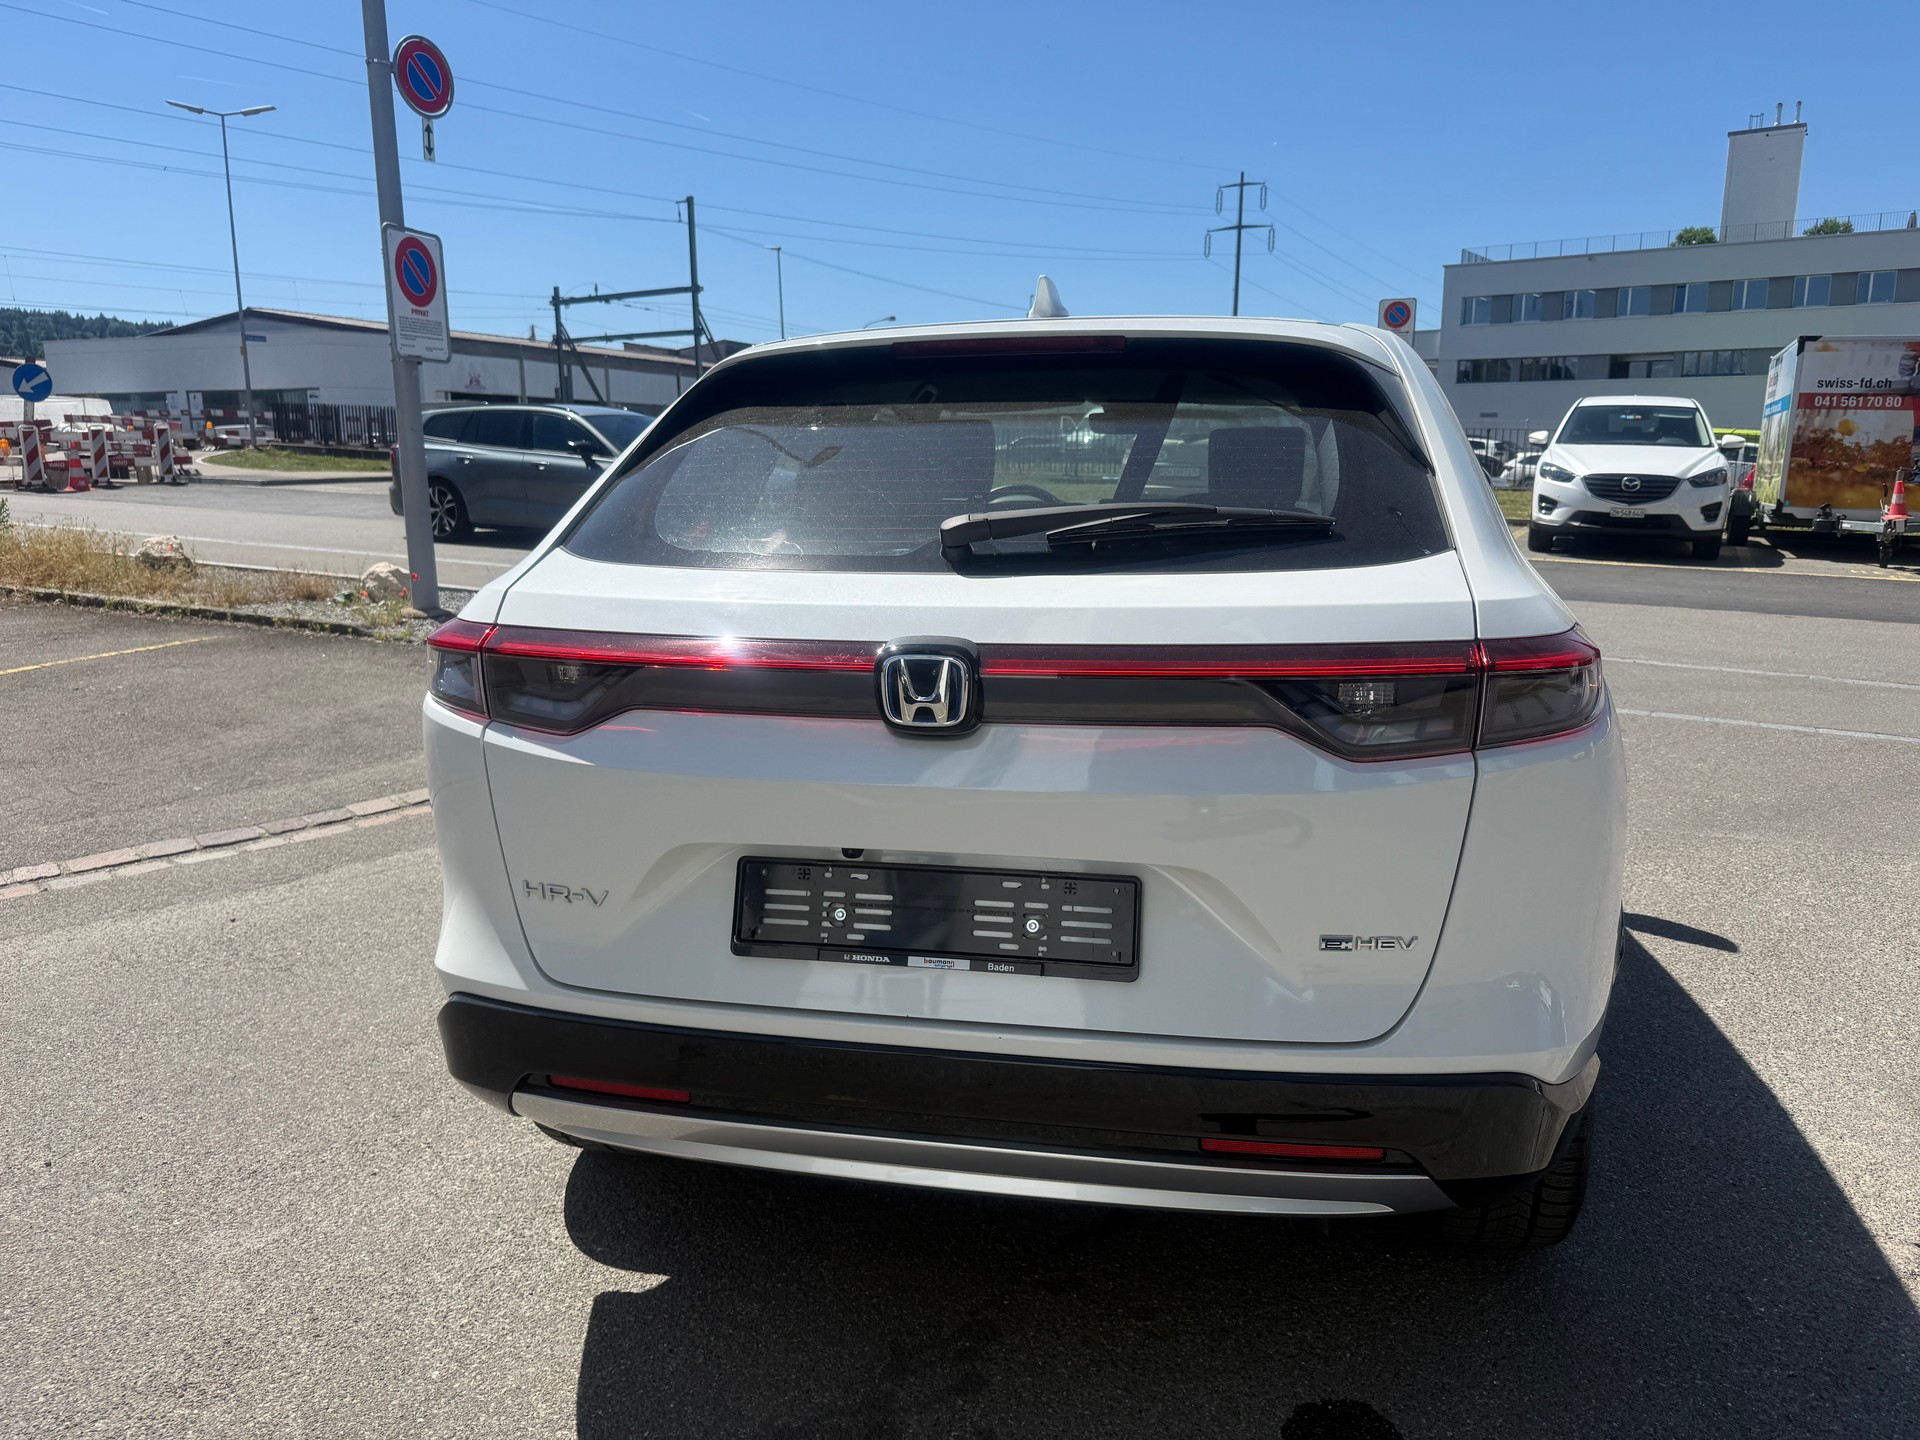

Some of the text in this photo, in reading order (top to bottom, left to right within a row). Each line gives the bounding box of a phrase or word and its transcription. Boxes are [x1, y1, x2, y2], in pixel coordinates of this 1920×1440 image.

[411, 308, 429, 317] PRIVAT
[1817, 377, 1892, 389] swiss-fd.ch
[1814, 396, 1902, 407] 041 561 70 80
[522, 880, 609, 907] HR-V
[852, 954, 891, 963] HONDA
[923, 957, 955, 967] baumann
[987, 963, 1015, 972] Baden
